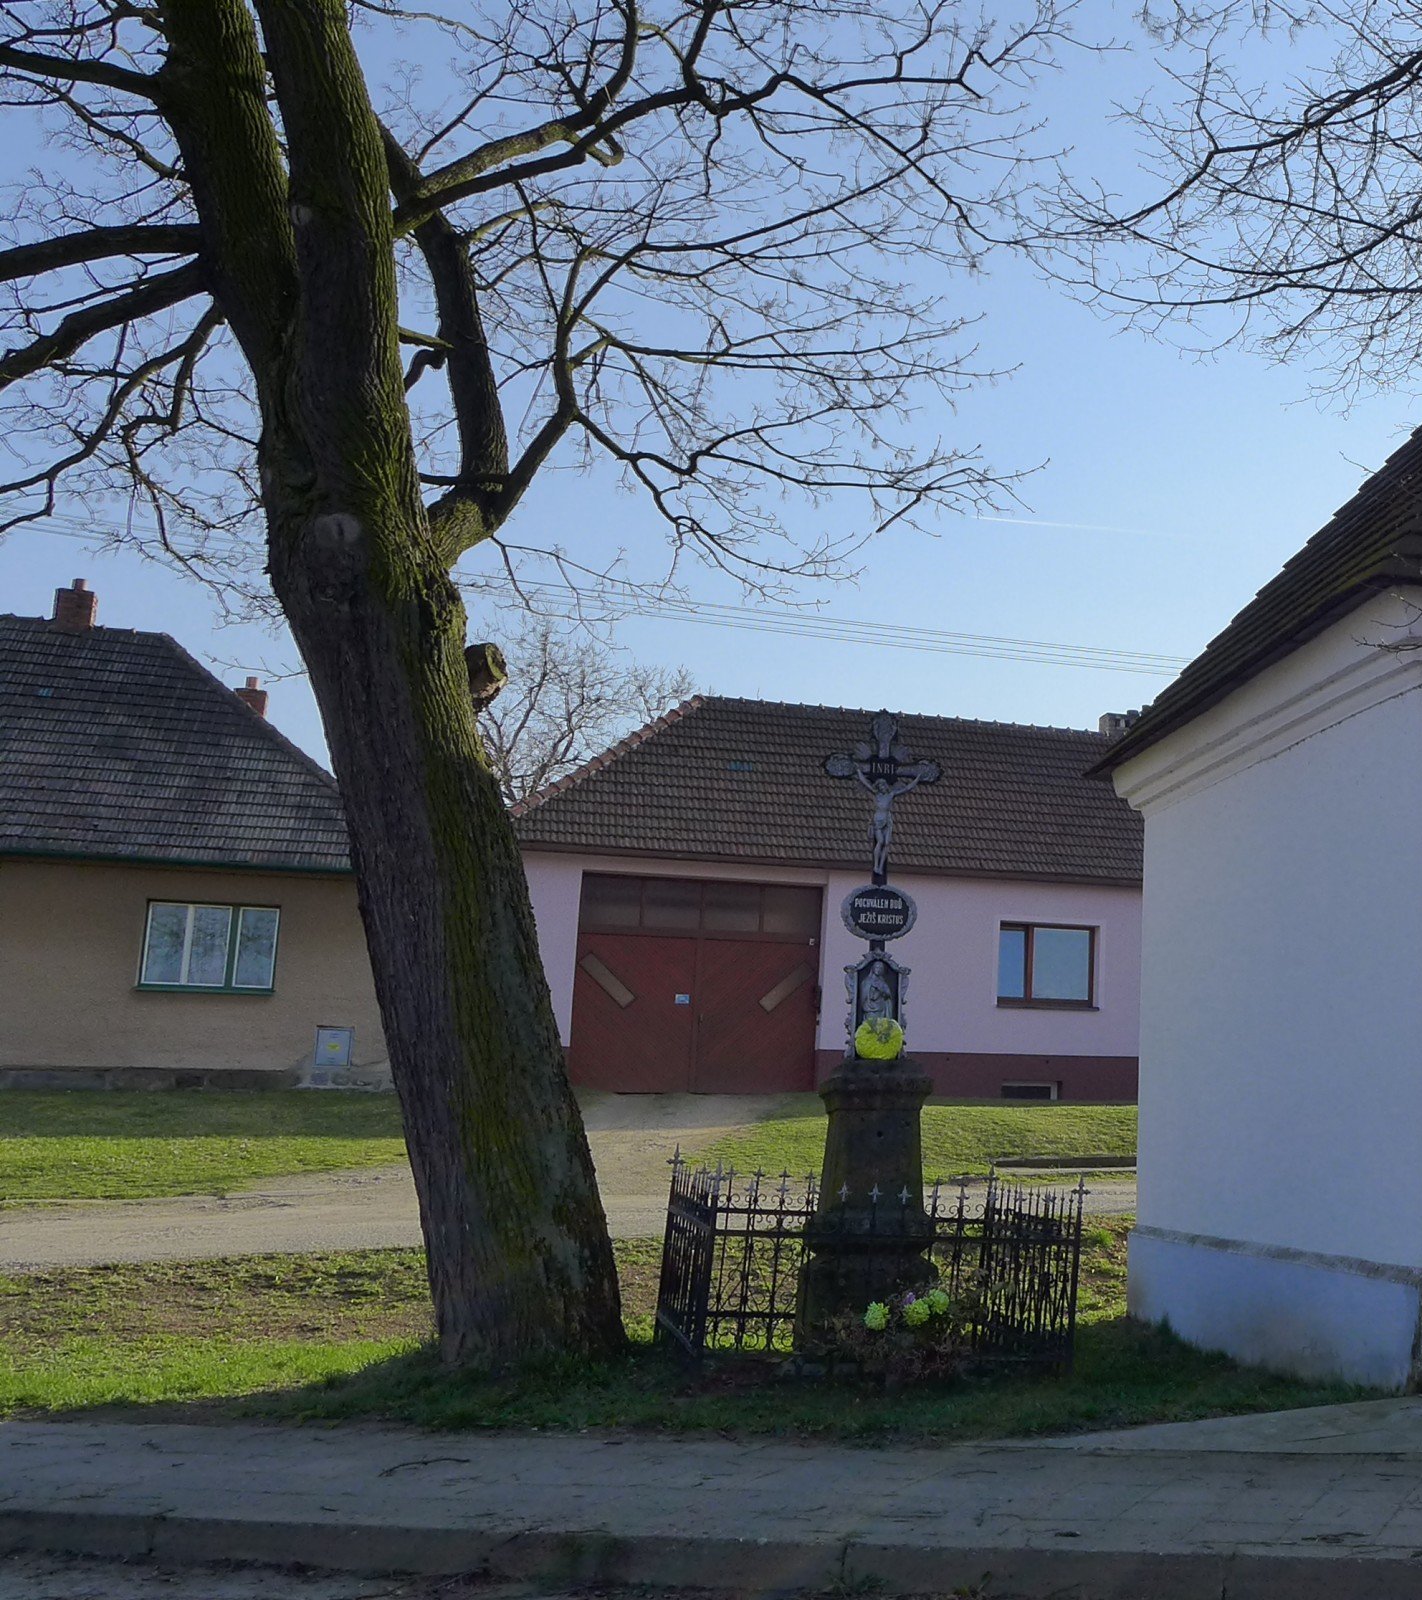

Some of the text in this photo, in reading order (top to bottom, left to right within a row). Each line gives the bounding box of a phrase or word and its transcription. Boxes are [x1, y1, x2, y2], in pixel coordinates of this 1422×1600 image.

[872, 762, 894, 774] INRI
[858, 911, 903, 925] JEŽIŠ KRISTUS
